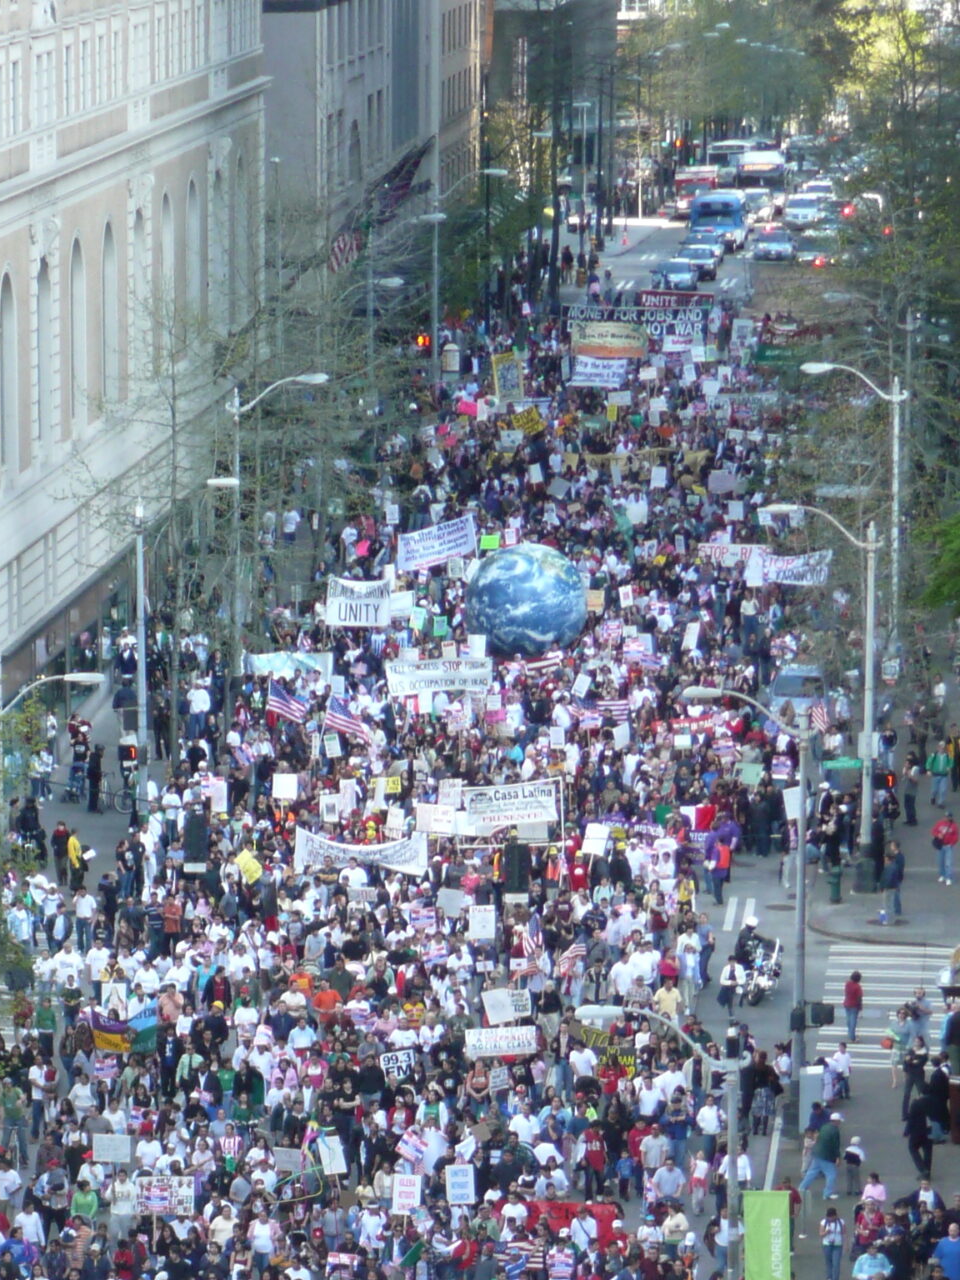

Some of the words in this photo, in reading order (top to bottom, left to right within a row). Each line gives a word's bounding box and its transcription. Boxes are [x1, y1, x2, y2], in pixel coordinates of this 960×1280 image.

[641, 294, 677, 306] UNITE
[568, 307, 608, 320] MONEY
[613, 308, 637, 320] FOR
[641, 308, 672, 322] JOBS
[677, 308, 702, 320] AND
[644, 322, 666, 335] NOT
[675, 322, 703, 335] WAR
[338, 602, 380, 624] UNITY
[442, 660, 462, 673] STOP
[493, 789, 519, 801] Casa
[522, 786, 553, 799] Latina
[471, 1042, 502, 1050] SOCIAL
[506, 1040, 533, 1049] CLASS
[382, 1052, 412, 1066] 99.3
[385, 1064, 413, 1078] FM
[770, 1217, 782, 1280] ADDRESS
